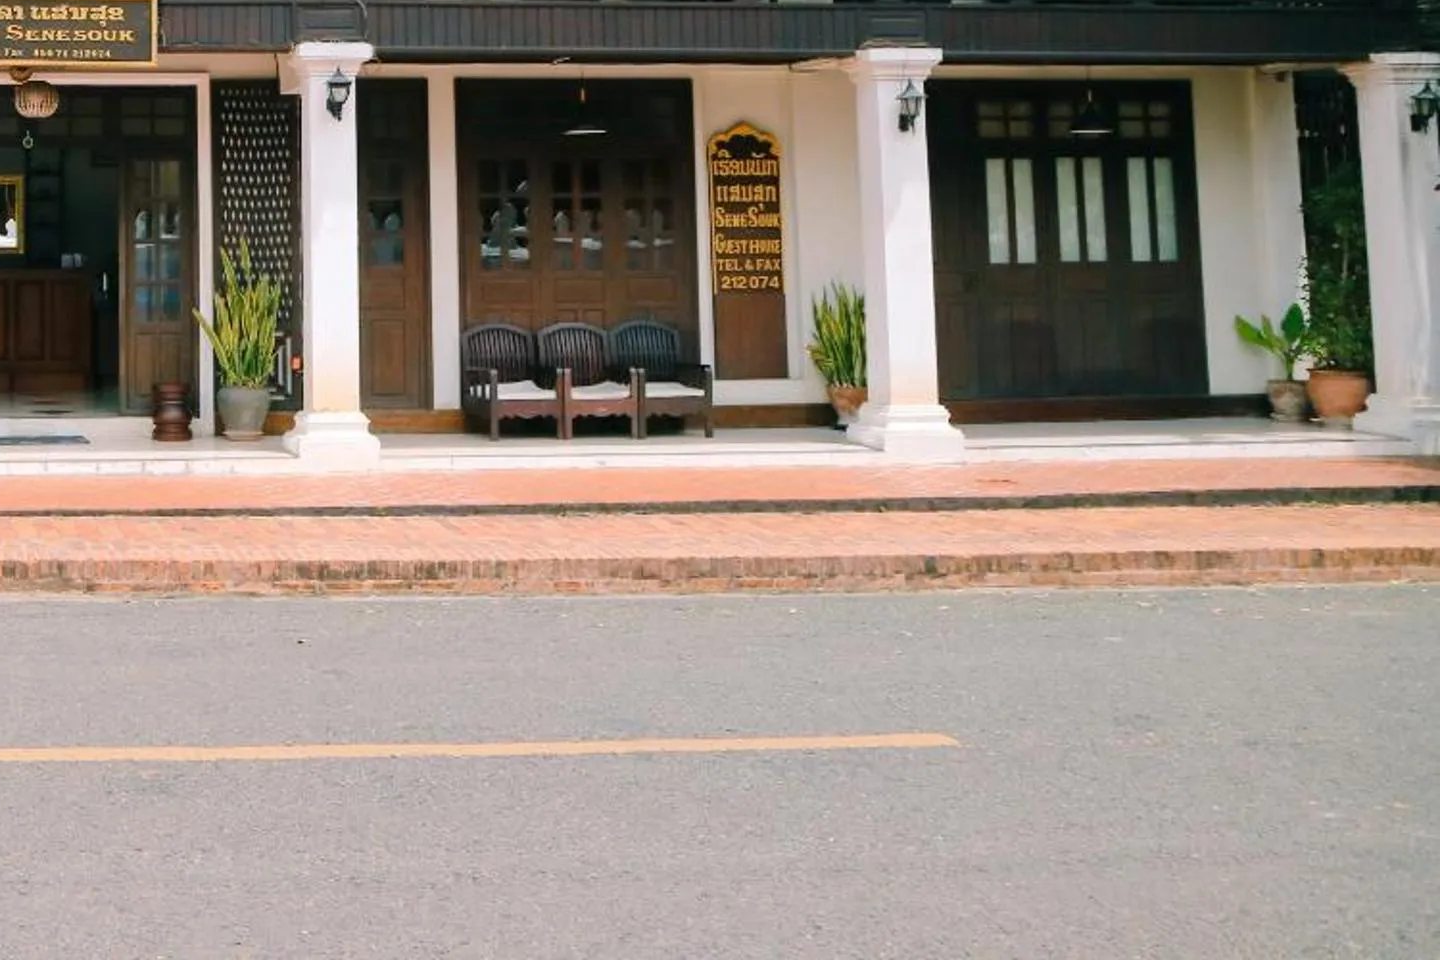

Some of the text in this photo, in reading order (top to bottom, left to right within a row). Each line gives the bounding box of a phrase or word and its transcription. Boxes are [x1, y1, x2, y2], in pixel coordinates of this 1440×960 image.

[6, 24, 136, 42] SENESOUK
[718, 259, 743, 271] TEL
[756, 259, 780, 271] FAX
[721, 276, 779, 289] 212 074
